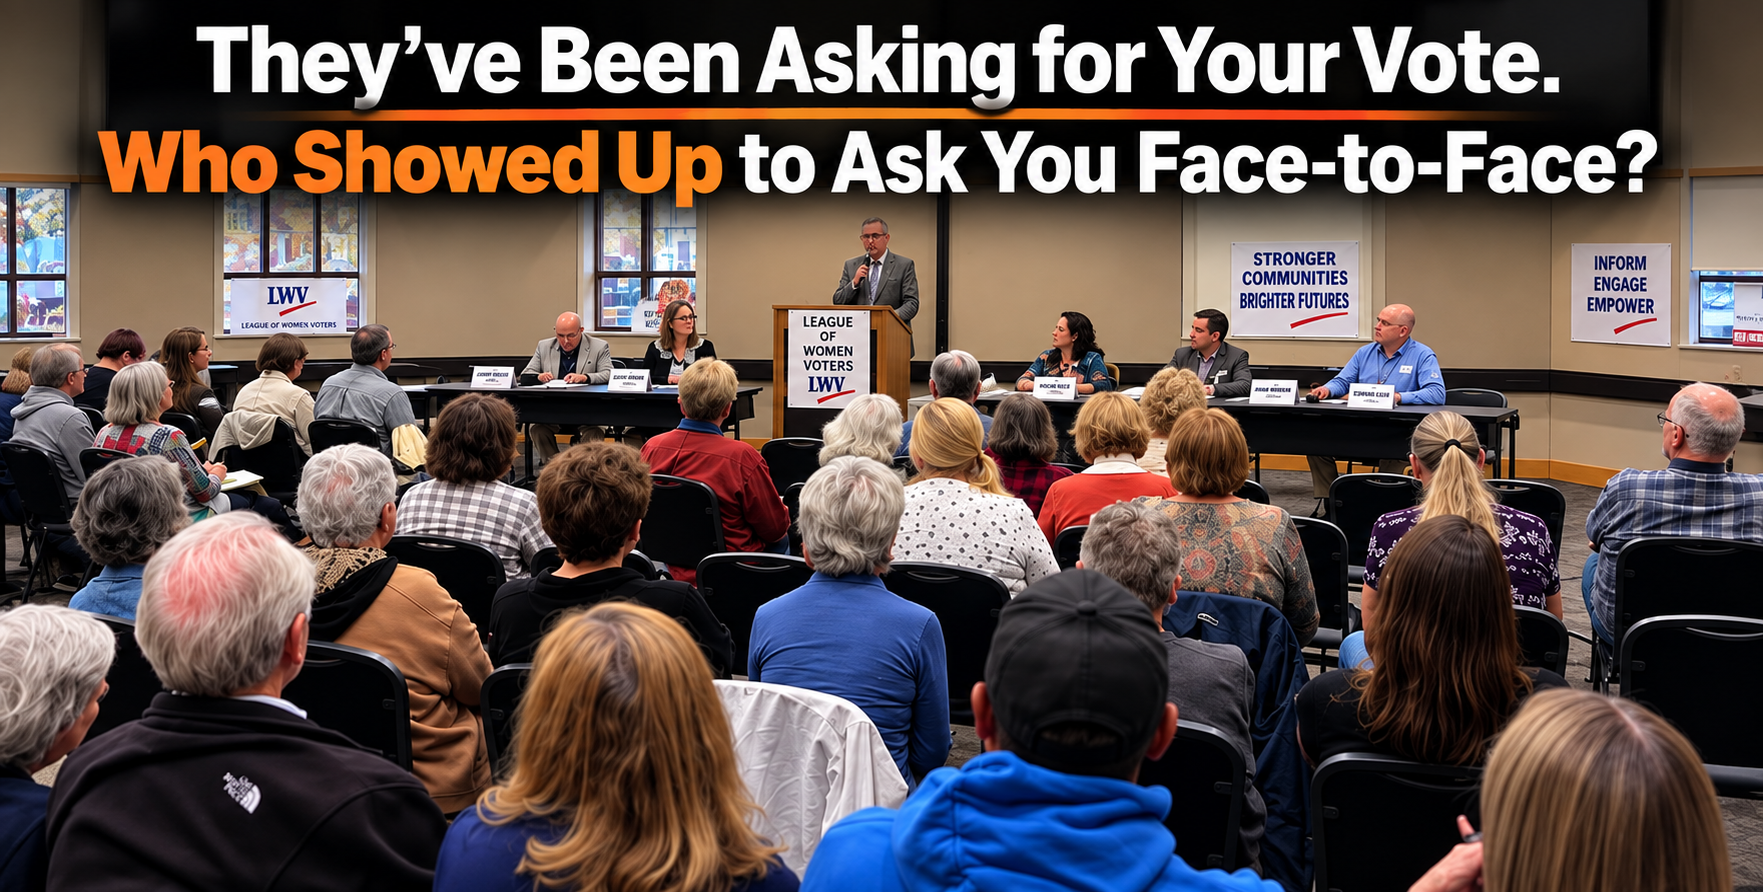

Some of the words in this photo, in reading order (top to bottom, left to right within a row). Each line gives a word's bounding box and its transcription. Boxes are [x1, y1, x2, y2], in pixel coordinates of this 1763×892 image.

[1253, 251, 1337, 266] STRONGER
[1594, 255, 1647, 271] INFORM
[1242, 270, 1349, 286] COMMUNITIES
[1594, 276, 1648, 292] ENGAGE
[266, 286, 309, 305] LWV
[1239, 292, 1295, 309] BRIGHTER
[1298, 292, 1350, 309] FUTURES
[1587, 296, 1655, 314] EMPOWER
[241, 321, 269, 329] LEAGUE
[281, 321, 309, 329] WOMEN
[311, 321, 337, 329] VOTERS
[803, 316, 853, 328] LEAGUE
[819, 331, 837, 342] OF
[803, 345, 853, 357] WOMEN
[803, 360, 854, 372] VOTERS
[808, 376, 846, 392] LWV
